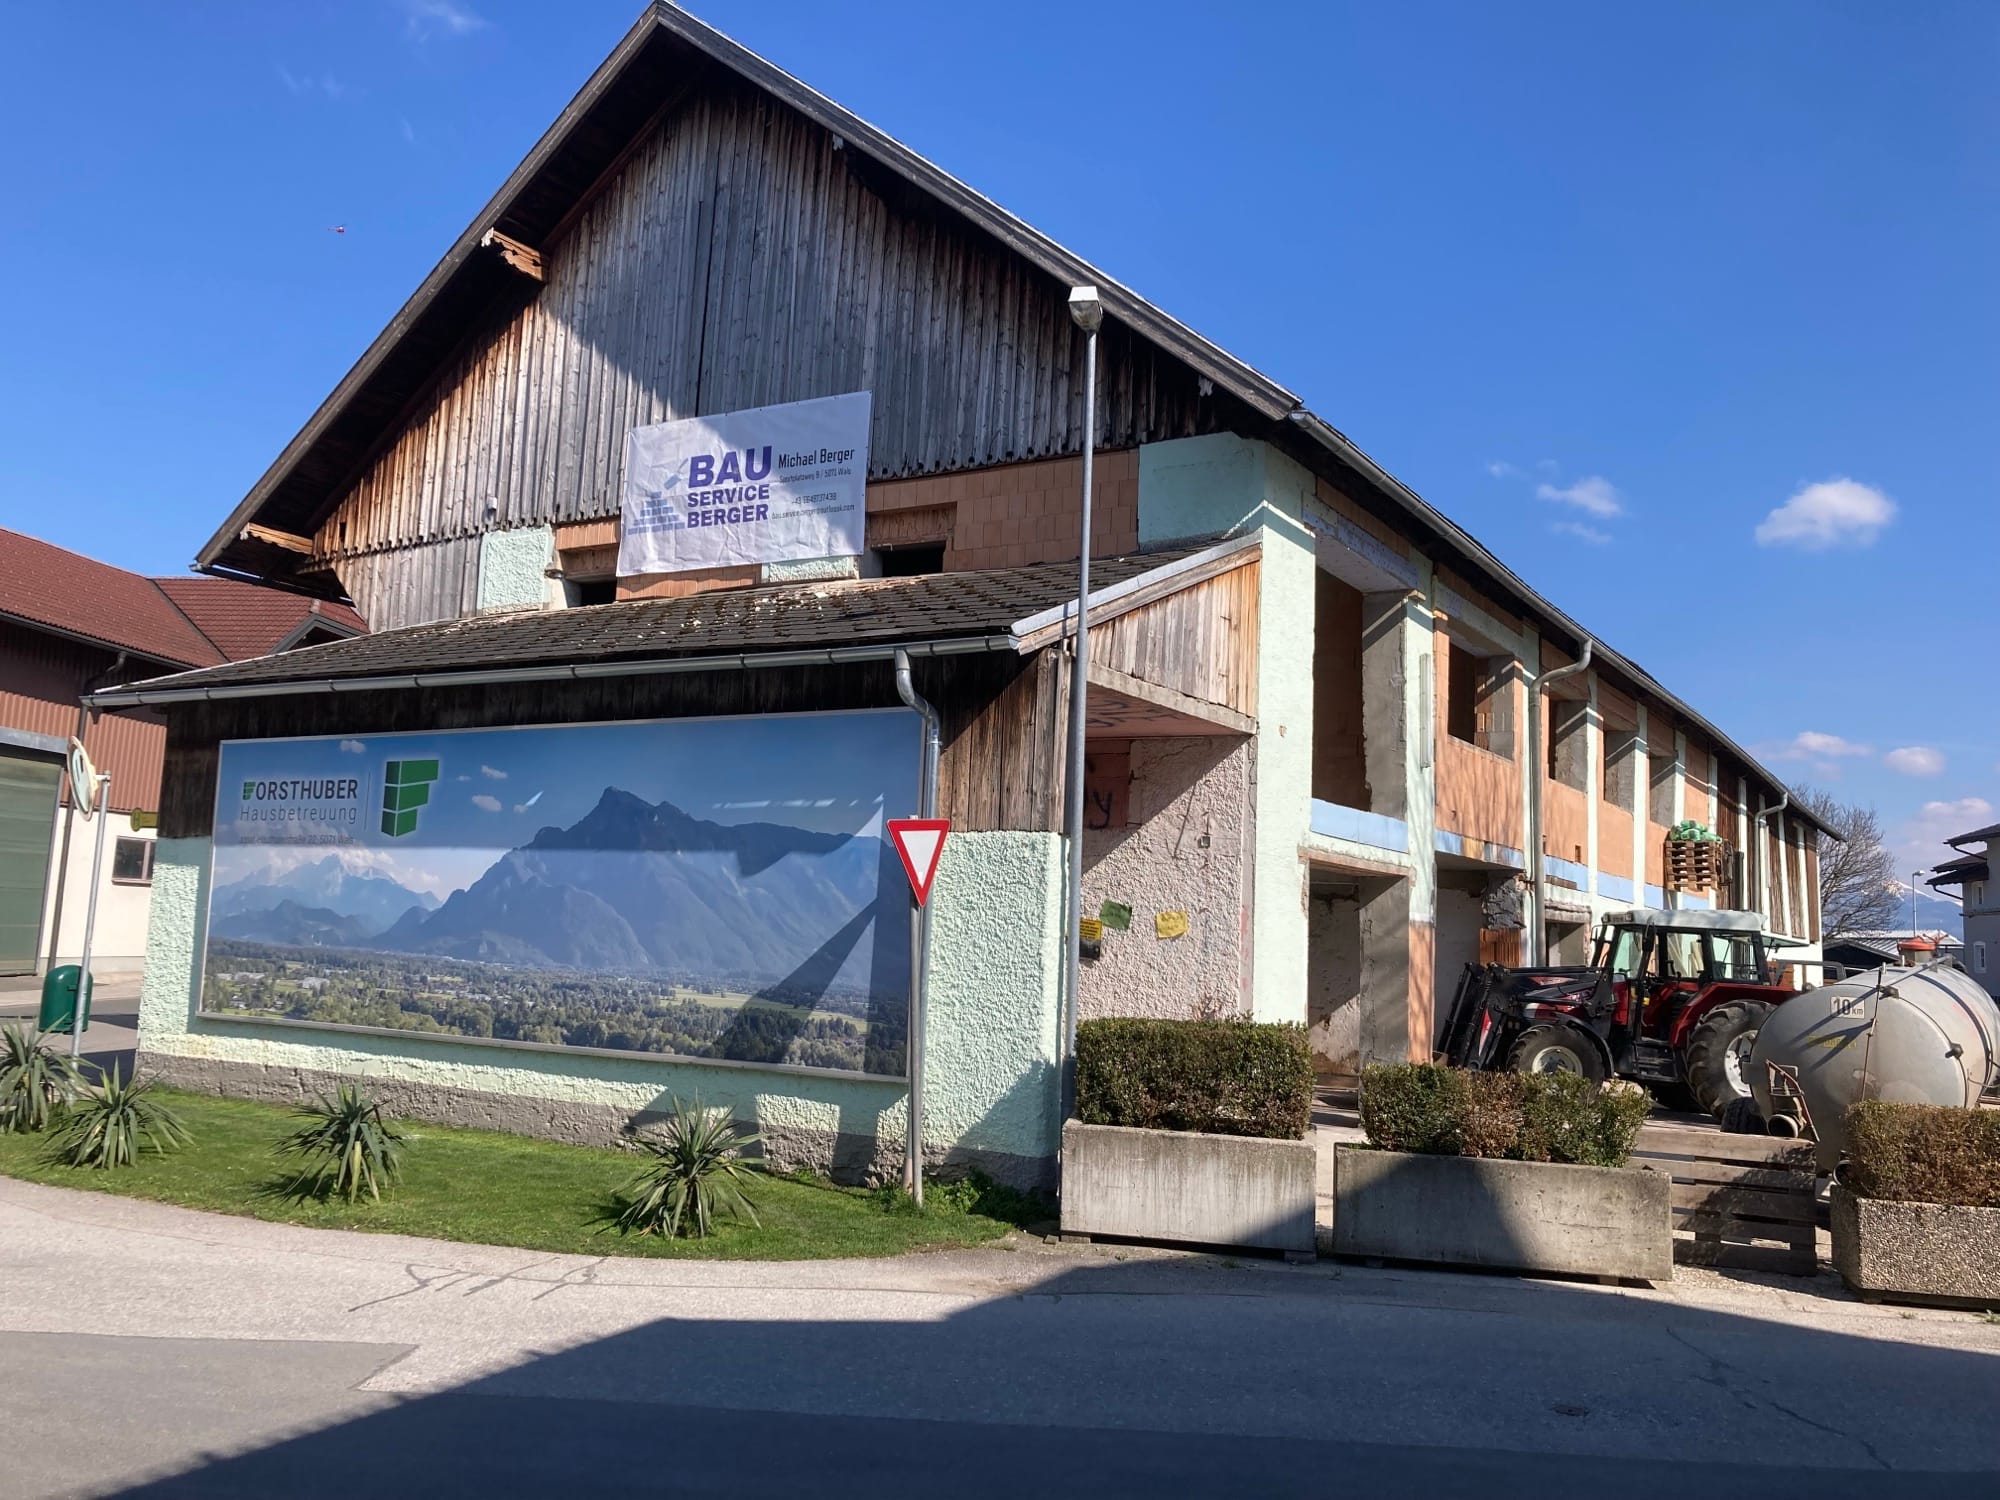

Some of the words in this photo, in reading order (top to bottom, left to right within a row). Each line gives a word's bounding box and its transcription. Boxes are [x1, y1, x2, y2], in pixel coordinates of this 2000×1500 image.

[688, 446, 772, 488] BAU
[778, 450, 817, 469] Michael
[820, 448, 855, 464] Berger
[824, 468, 837, 478] 5071
[687, 484, 770, 507] SERVICE
[687, 504, 769, 528] BERGER
[243, 779, 358, 800] FORSTHUBER
[240, 804, 358, 825] Hausbetreuung
[1833, 998, 1851, 1016] 10
